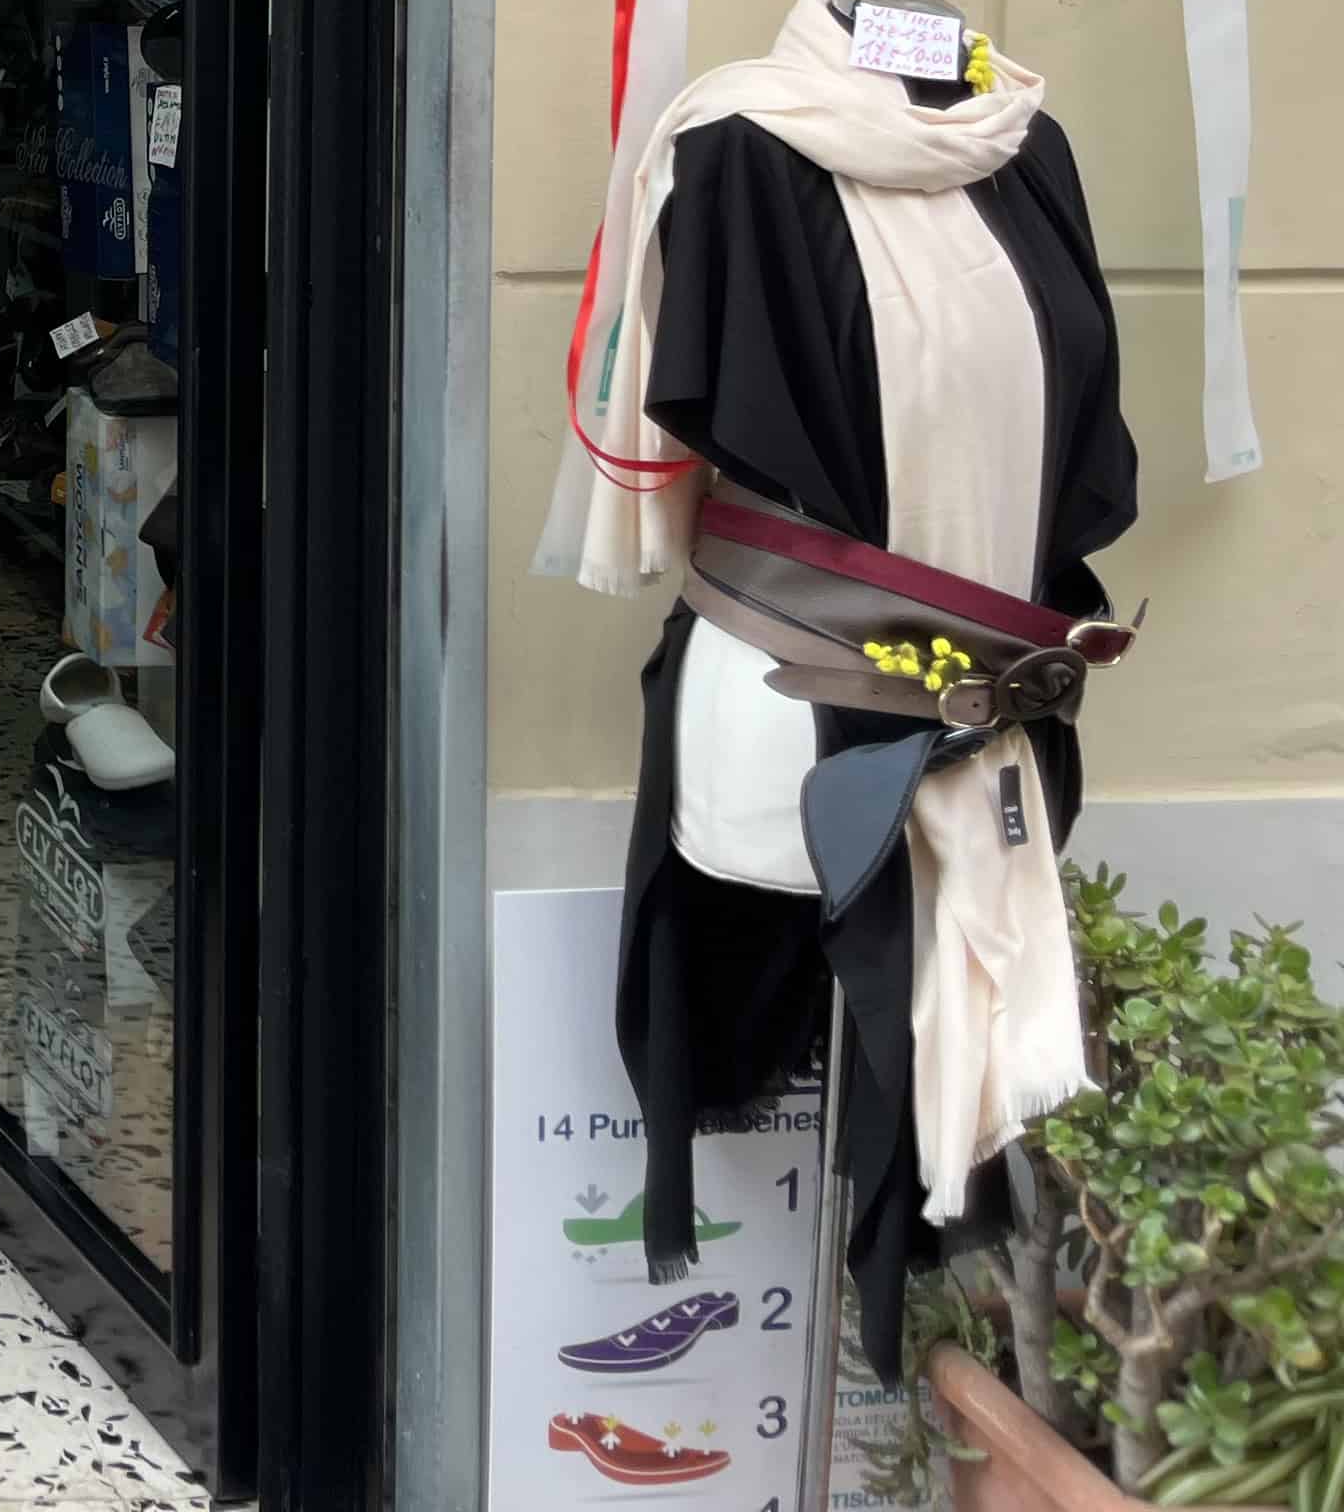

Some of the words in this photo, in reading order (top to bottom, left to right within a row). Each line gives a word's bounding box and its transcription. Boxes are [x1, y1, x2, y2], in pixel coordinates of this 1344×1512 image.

[589, 1113, 645, 1140] Pun
[775, 1166, 799, 1213] 1
[760, 1285, 793, 1331] 2
[756, 1395, 788, 1439] 3
